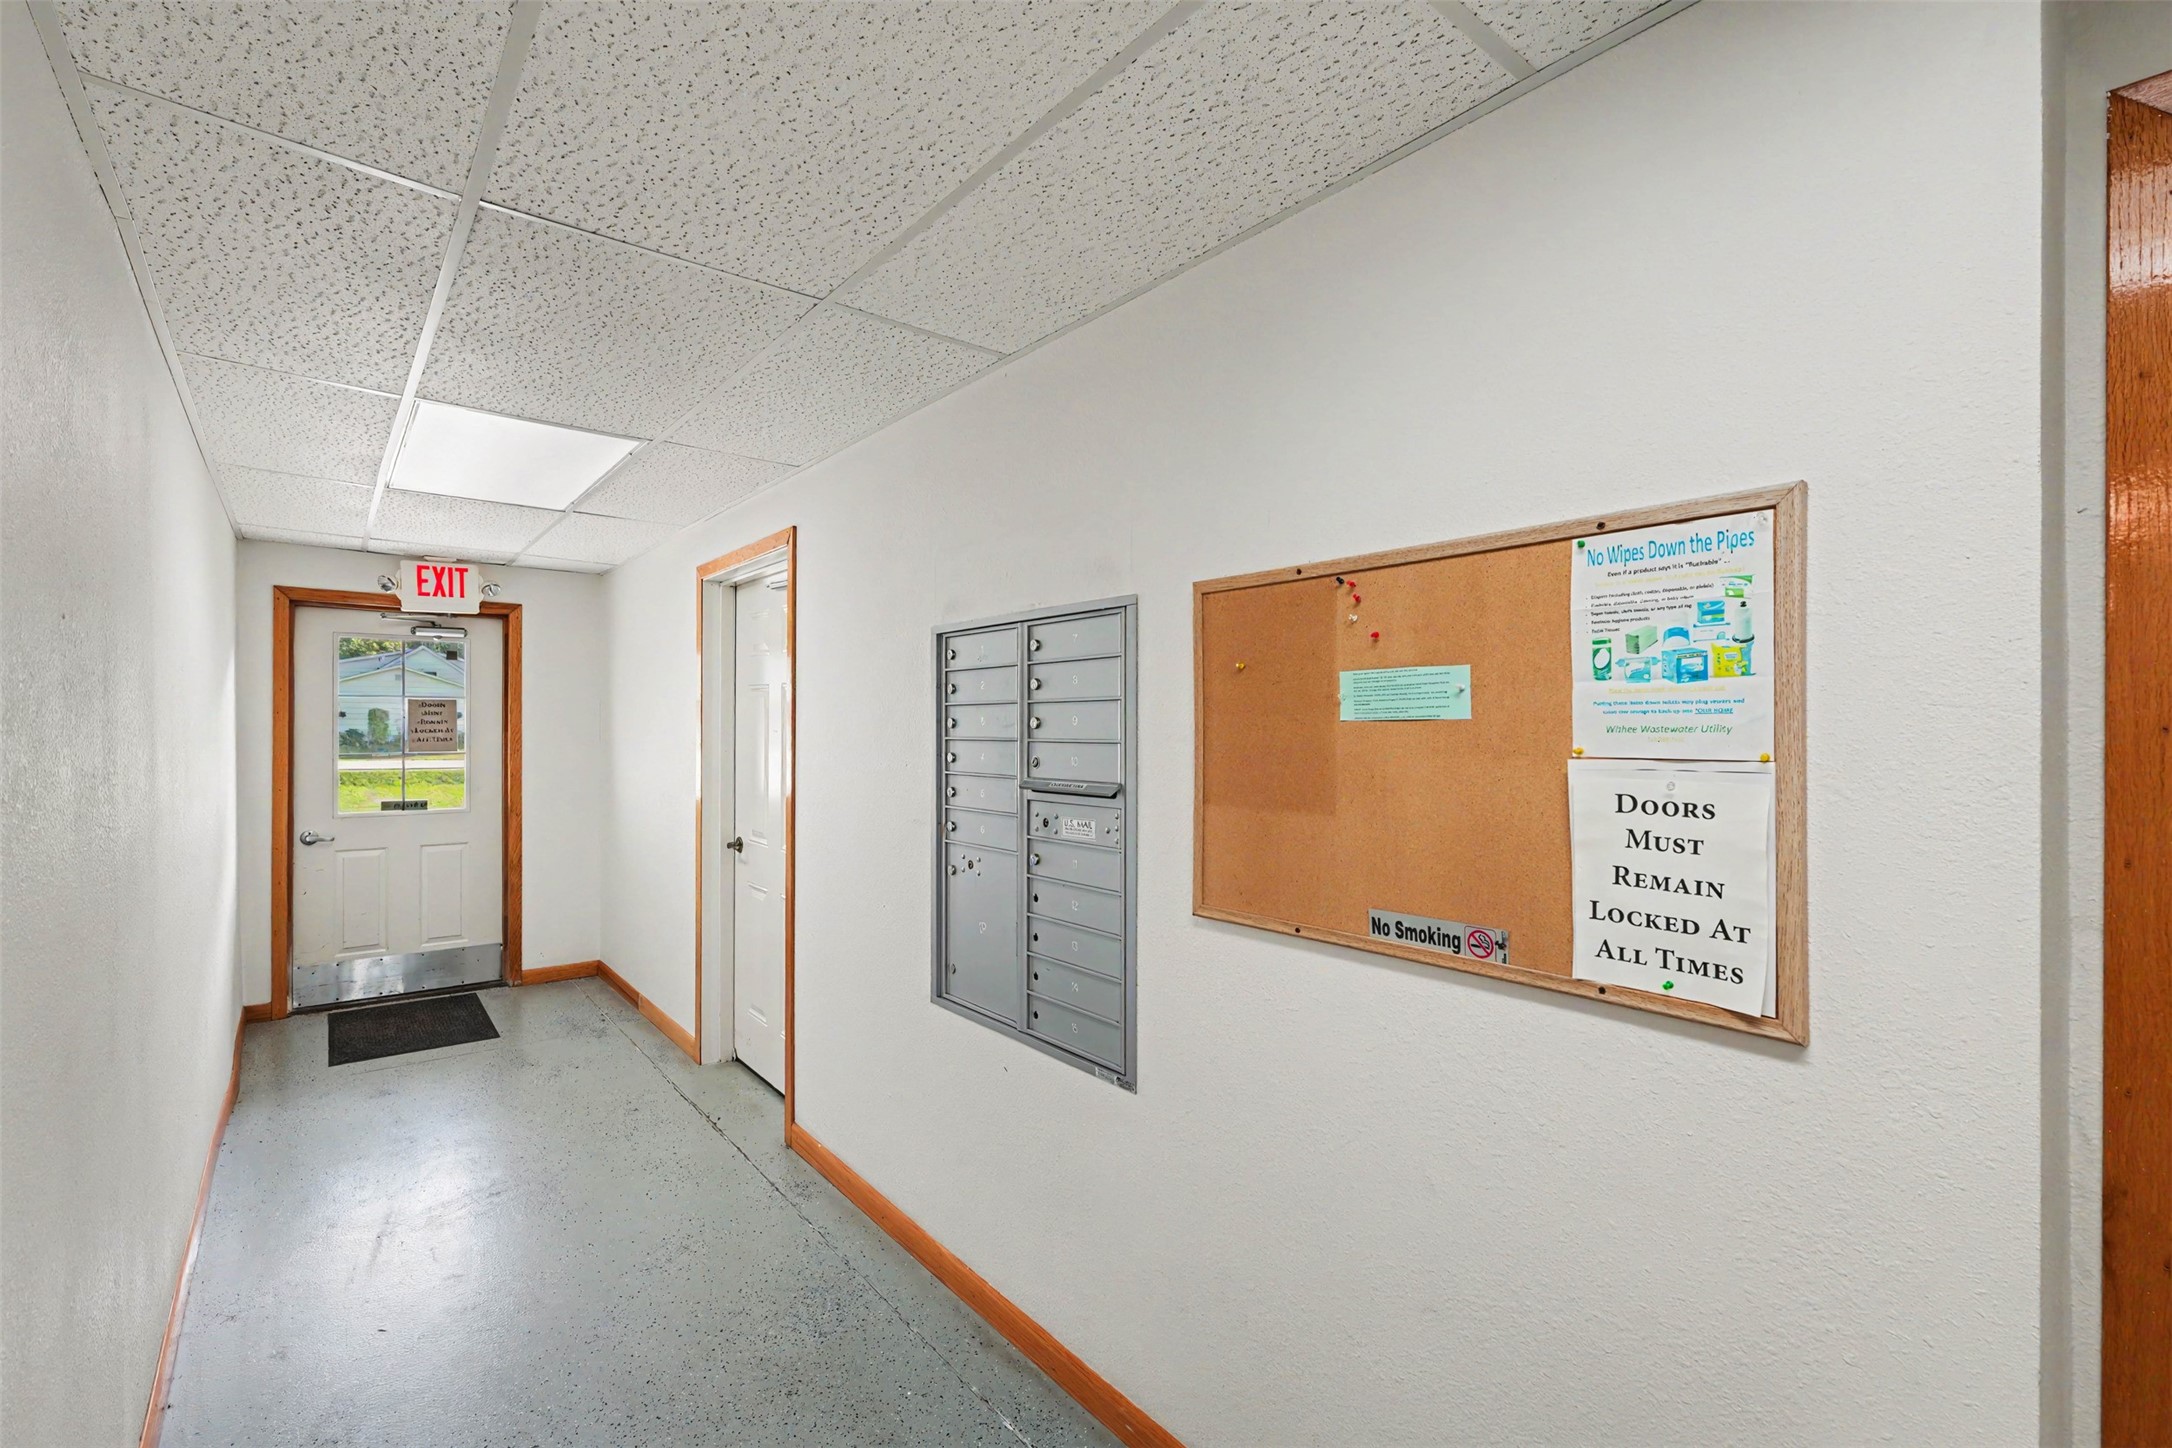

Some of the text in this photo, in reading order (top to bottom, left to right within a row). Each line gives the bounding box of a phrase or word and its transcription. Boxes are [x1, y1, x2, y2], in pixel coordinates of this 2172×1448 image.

[1587, 529, 1755, 567] No Wipes Down the Pipes
[416, 564, 469, 598] EXIT
[1633, 567, 1657, 575] product
[1640, 725, 1698, 733] Wastewater
[1701, 723, 1733, 735] Utility
[1614, 793, 1716, 820] DOORS
[1077, 820, 1093, 830] MAIL
[1625, 828, 1704, 855] MUST
[1611, 865, 1725, 899] REMAIN
[1371, 916, 1461, 954] No Smoking
[1588, 899, 1751, 944] LOCKED AT
[1594, 938, 1744, 985] ALL TIMES
